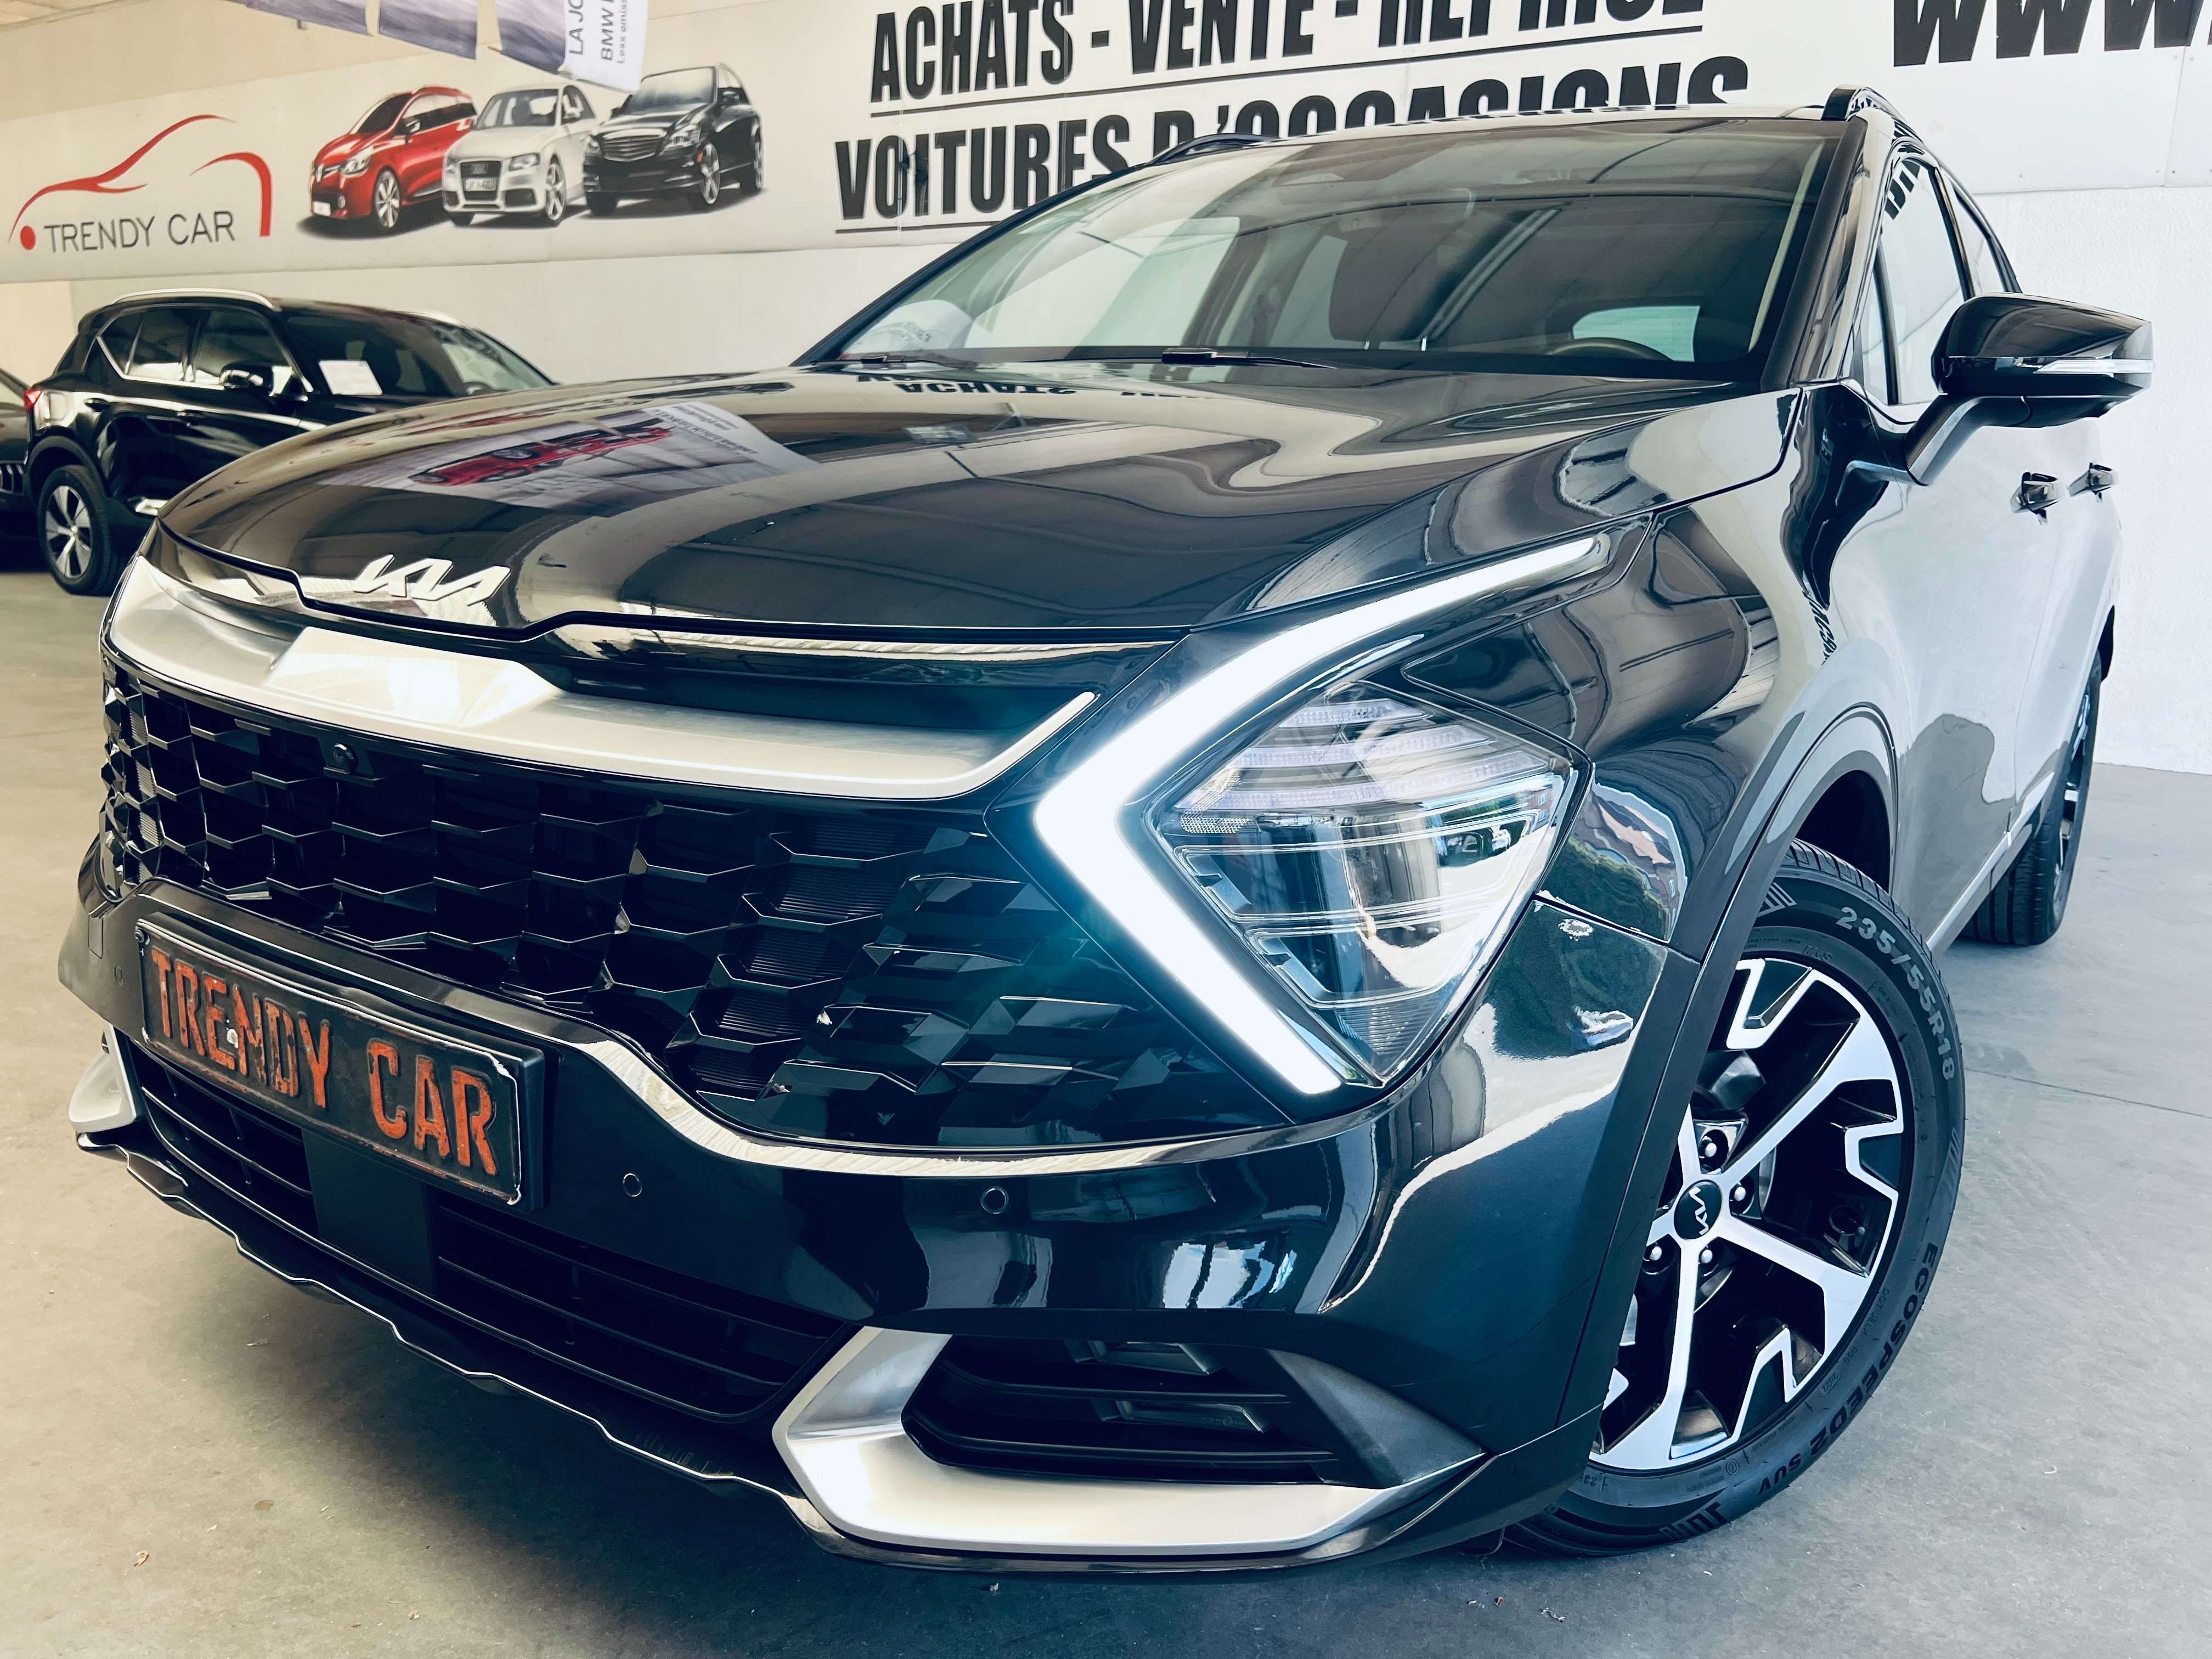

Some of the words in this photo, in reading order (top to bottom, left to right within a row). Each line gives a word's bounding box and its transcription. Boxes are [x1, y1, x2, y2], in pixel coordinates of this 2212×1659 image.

[569, 28, 584, 55] LA
[601, 8, 614, 60] BMW
[870, 0, 1074, 103] ACHATS
[1129, 0, 1314, 74] VENTE
[835, 115, 1130, 220] VOITURES
[44, 216, 156, 253] TRENDY
[167, 211, 235, 246] CAR
[353, 553, 511, 606] KIA
[1836, 906, 1955, 1080] 235/55R18
[151, 949, 330, 1108] TRENDY
[368, 1039, 498, 1176] CAR
[1810, 1242, 1939, 1456] ECOSPEED2
[1757, 1453, 1802, 1496] SUV
